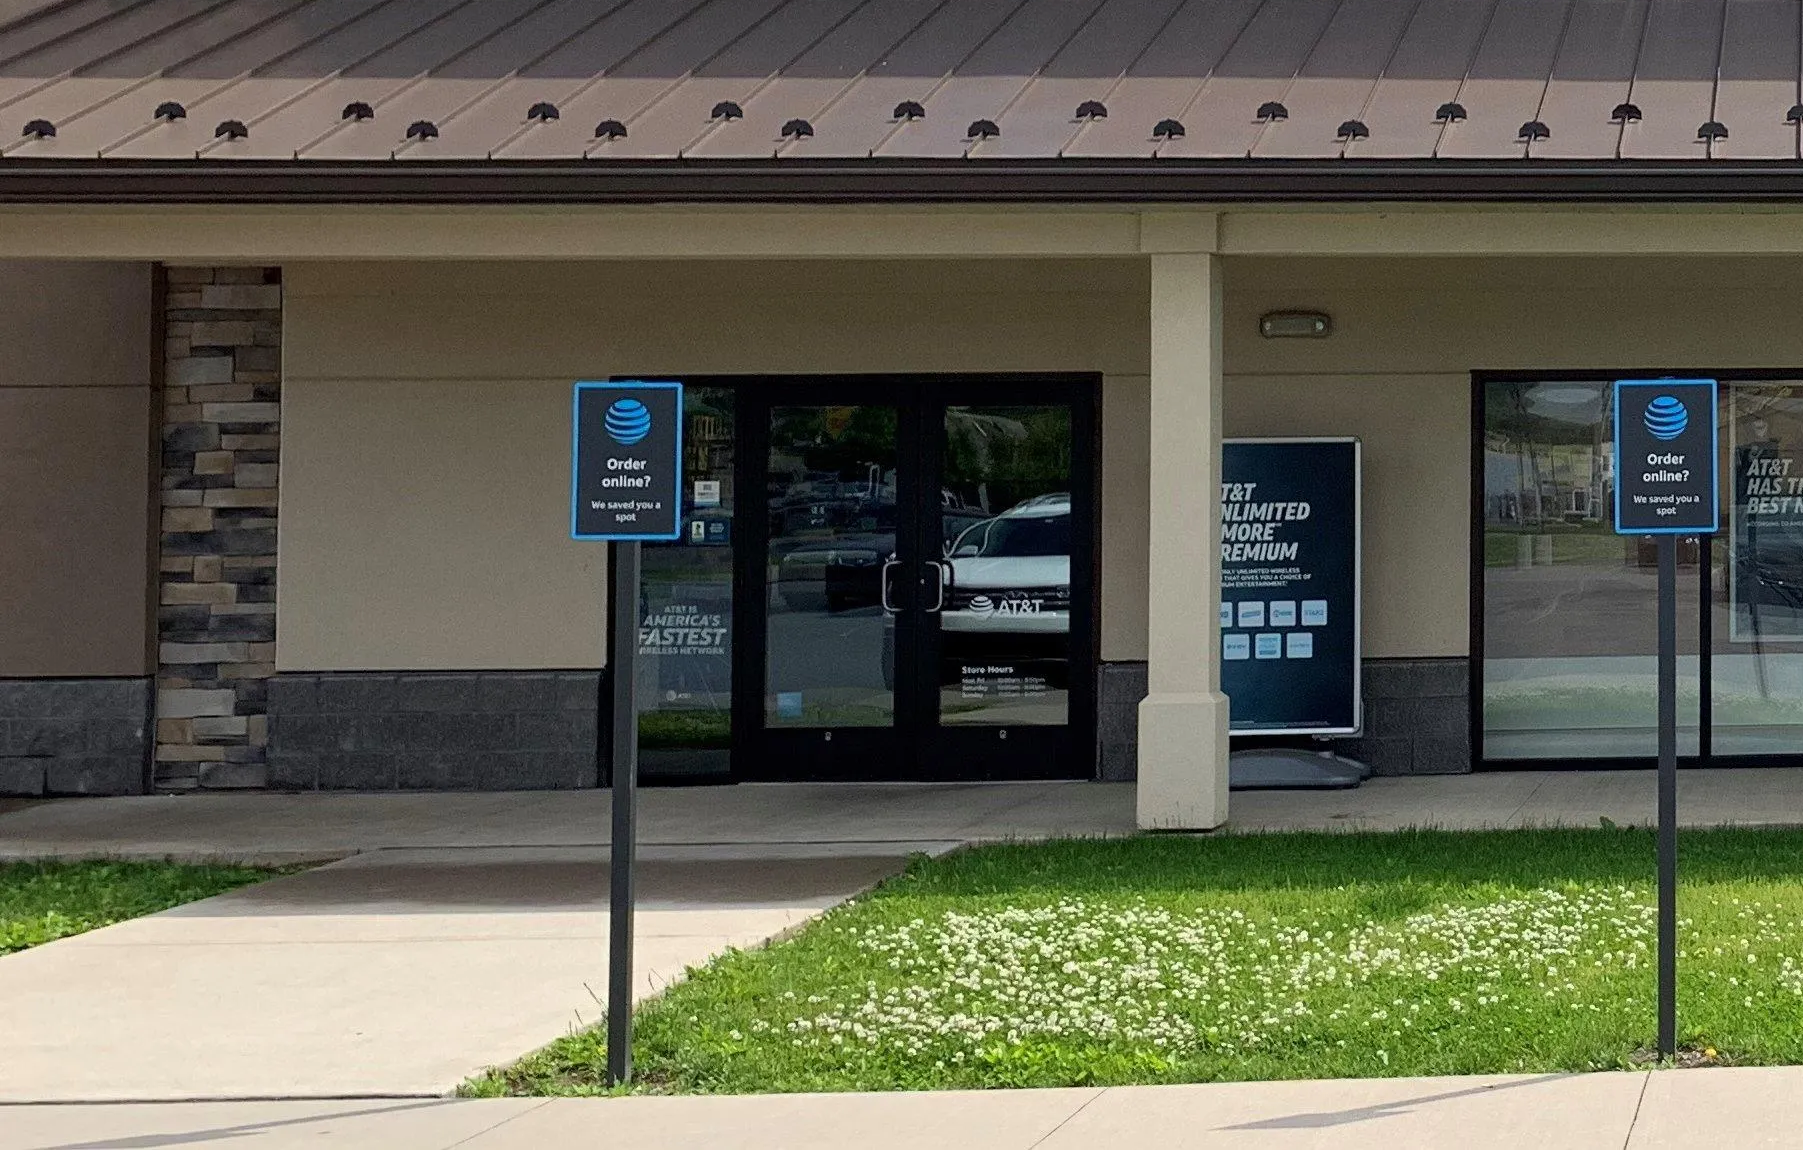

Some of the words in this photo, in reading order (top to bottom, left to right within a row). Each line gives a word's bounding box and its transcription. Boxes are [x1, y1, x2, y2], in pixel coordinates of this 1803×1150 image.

[607, 458, 647, 470] Order
[1647, 453, 1685, 465] Order
[1747, 458, 1793, 477] AT&T
[601, 475, 651, 488] online?
[1642, 470, 1690, 482] online?
[1221, 482, 1257, 501] T&T
[1746, 477, 1783, 496] HAS
[591, 500, 606, 509] We
[607, 500, 635, 509] saved
[636, 501, 654, 511] you
[1633, 495, 1647, 503] We
[1648, 494, 1675, 503] saved
[1675, 495, 1693, 505] you
[1747, 496, 1792, 514] BEST
[615, 513, 637, 523] spot
[1221, 502, 1311, 521] NLIMITED
[1656, 507, 1677, 516] spot
[1221, 542, 1299, 561] REMIUM
[998, 600, 1045, 616] AT&T
[643, 614, 721, 627] AMERICA'S
[638, 627, 728, 646] FASTEST
[639, 647, 679, 655] IRELESS
[961, 665, 986, 675] Store
[987, 665, 1014, 674] Hours
